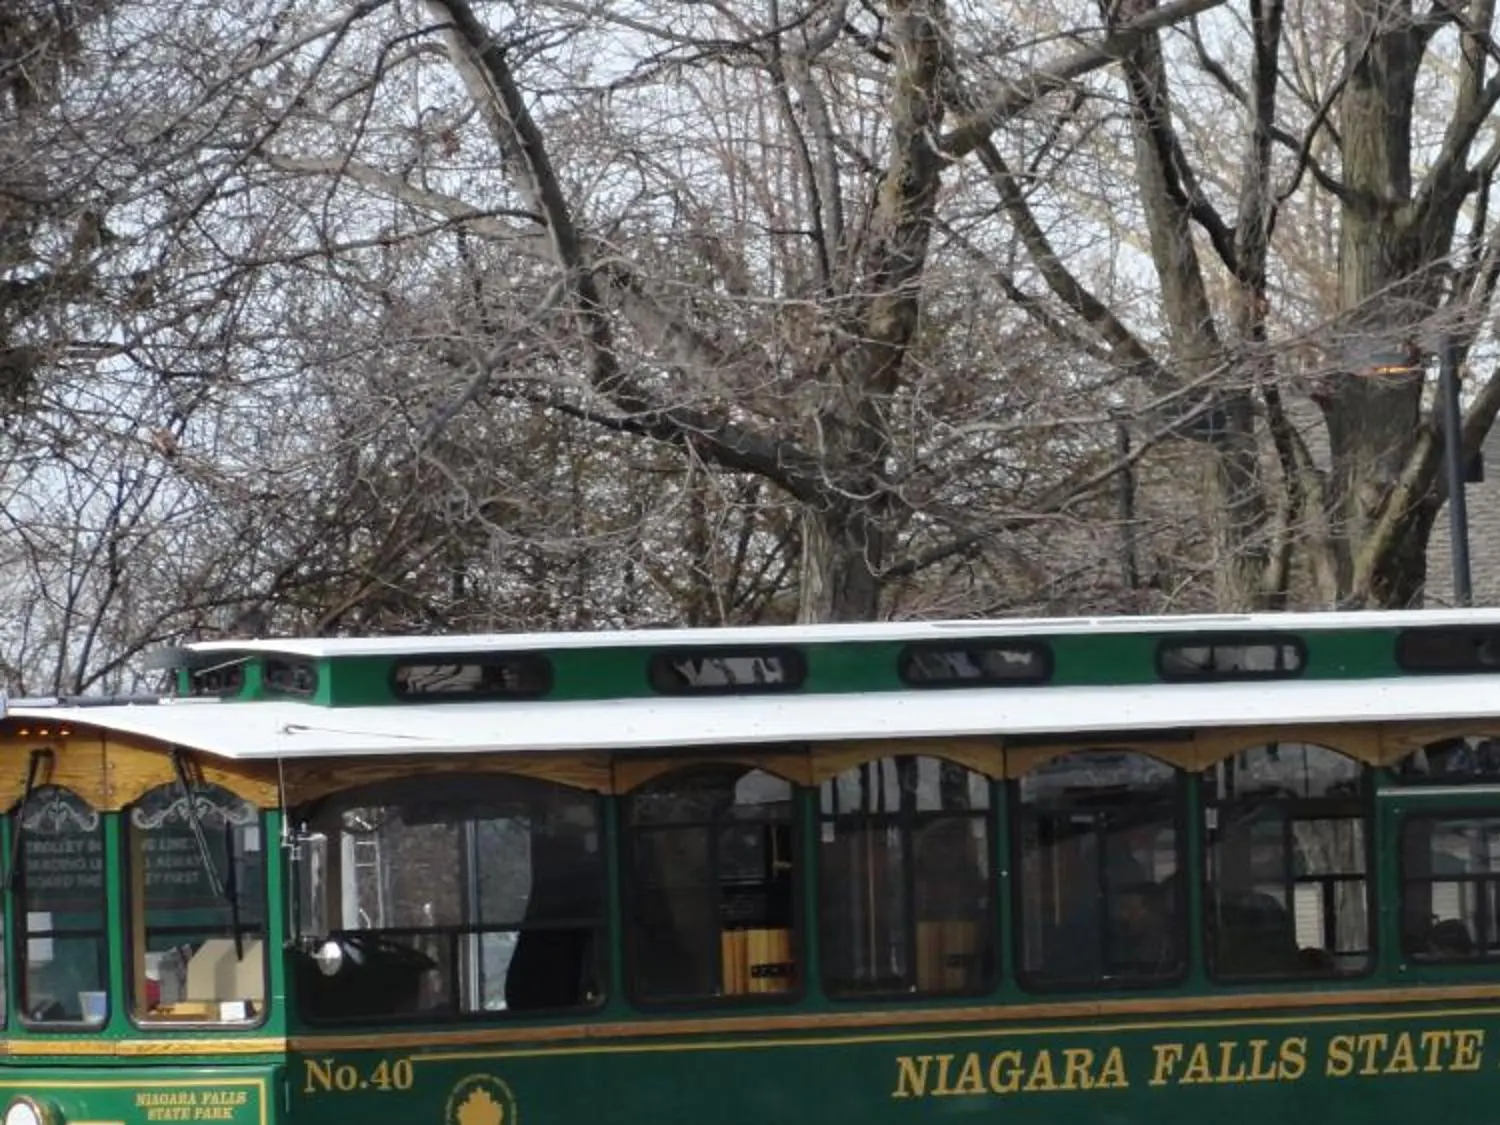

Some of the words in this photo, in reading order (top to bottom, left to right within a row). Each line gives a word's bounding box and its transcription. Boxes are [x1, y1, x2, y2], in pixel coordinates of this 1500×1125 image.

[891, 1046, 1130, 1098] NIAGARA
[1147, 1036, 1308, 1087] FALLS
[1325, 1027, 1486, 1078] STATE
[136, 1091, 197, 1107] NIAGARA
[202, 1090, 248, 1106] FALLS
[147, 1106, 190, 1121] STATE
[194, 1106, 234, 1120] PARK
